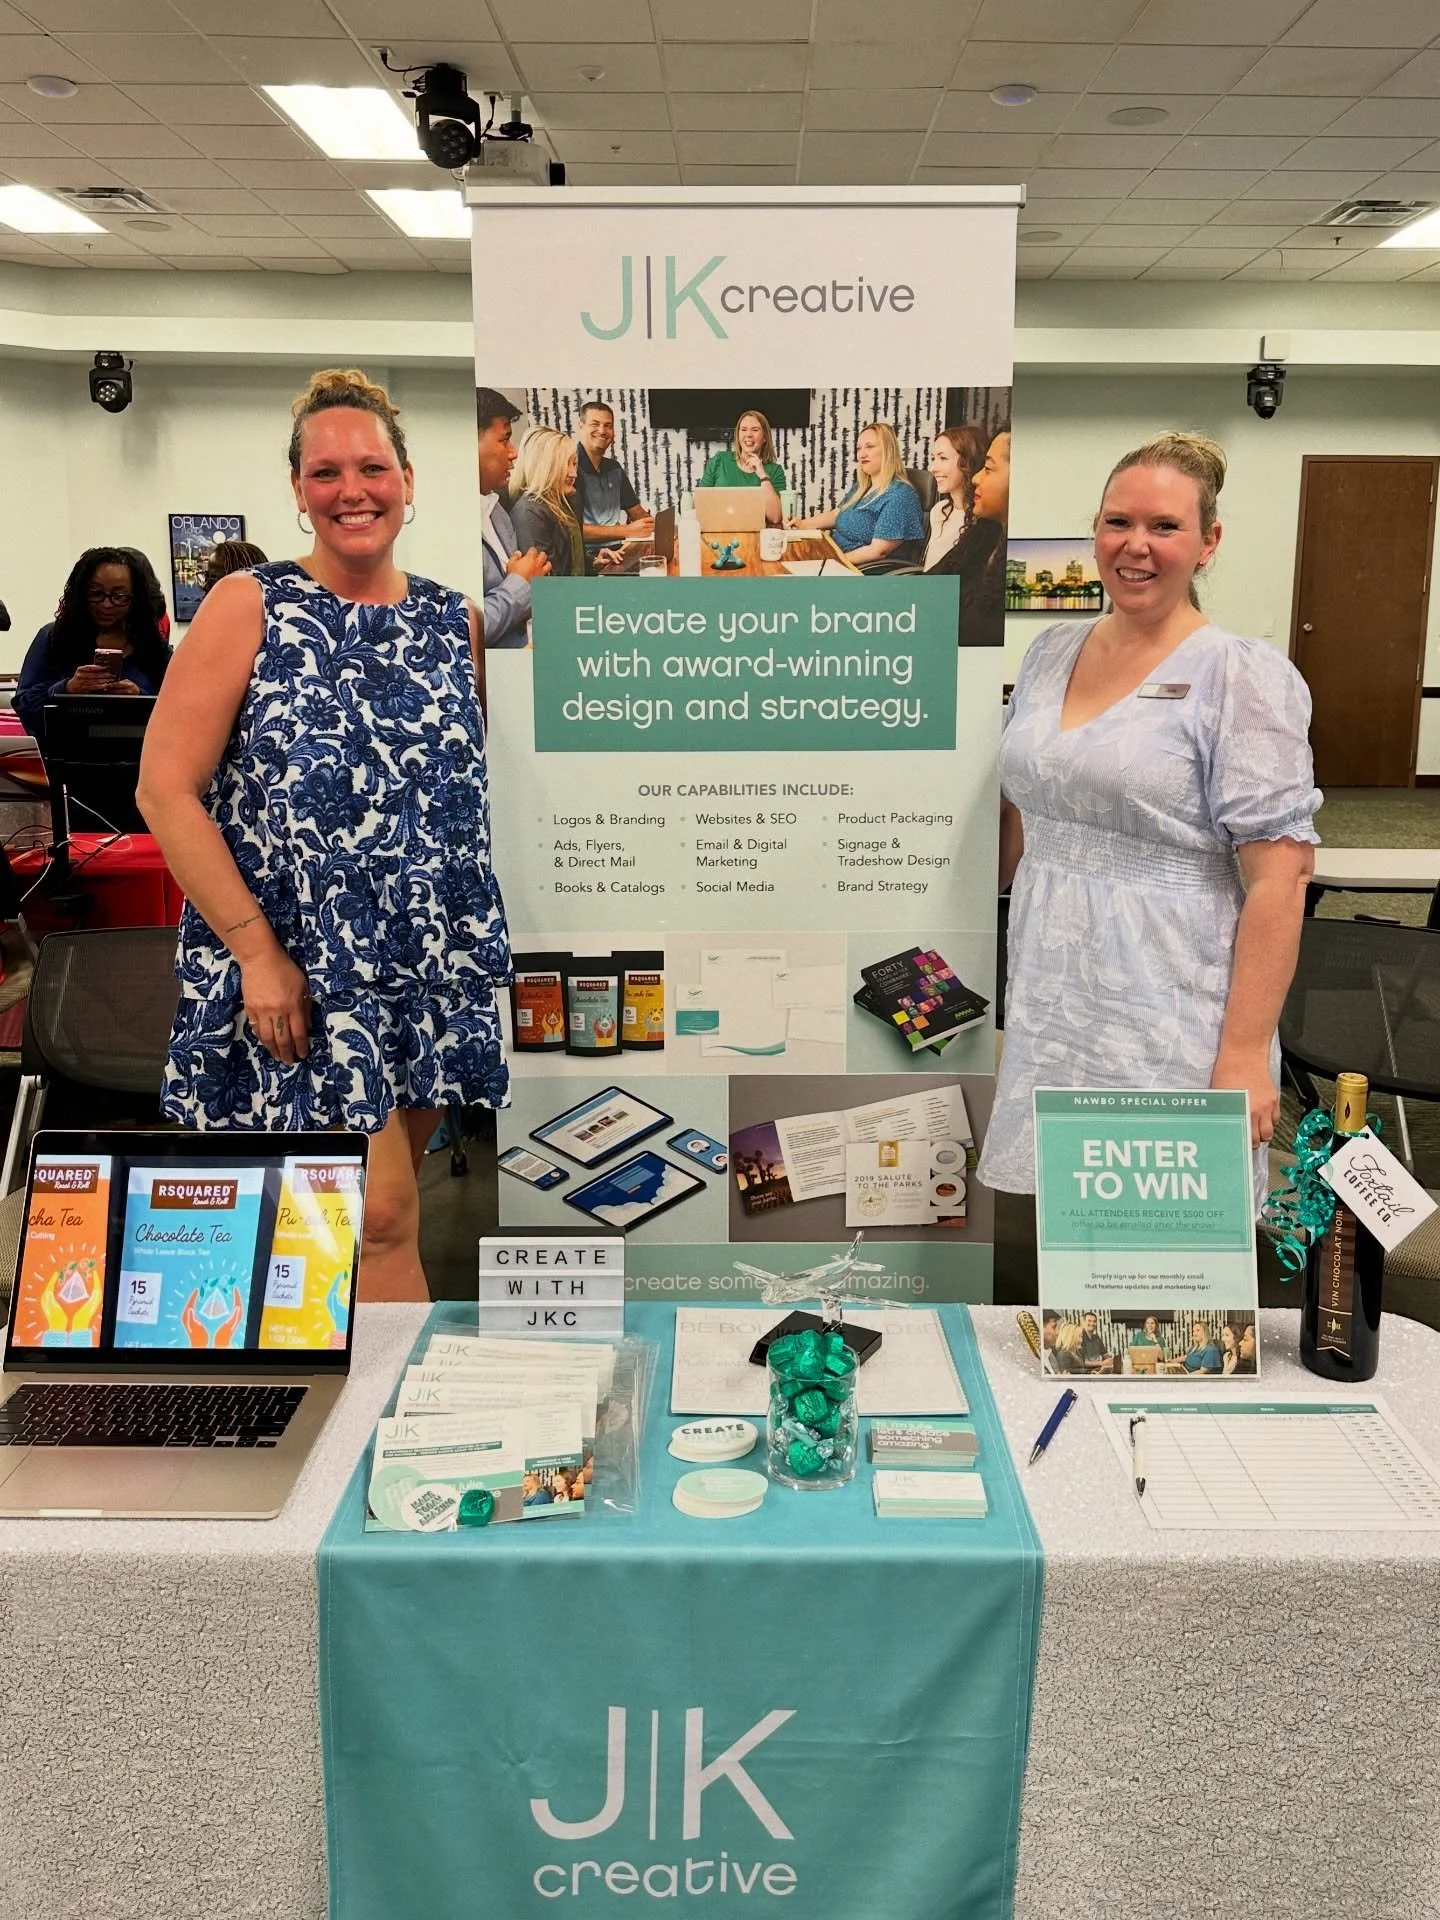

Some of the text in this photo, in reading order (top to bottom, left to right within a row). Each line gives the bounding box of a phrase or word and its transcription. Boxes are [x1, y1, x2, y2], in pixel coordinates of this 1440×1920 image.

[720, 276, 915, 313] creative
[172, 516, 240, 530] ORLANDO
[575, 604, 916, 643] Elevate your brand
[577, 648, 913, 685] with award-winning
[562, 691, 928, 730] design and strategy.
[638, 783, 854, 797] OUR CAPABILITIES INCLUDE:
[553, 813, 665, 828] Logos & Branding
[696, 813, 797, 825] Websites & SEO
[838, 812, 953, 827] Product Packaging
[553, 838, 625, 855] Ads, Flyers,
[696, 838, 787, 853] Email & Digital
[838, 838, 901, 852] Signage &
[553, 855, 636, 868] & Direct Mail
[696, 855, 758, 869] Marketing
[838, 854, 950, 868] Tradeshow Design
[555, 881, 665, 895] Books & Catalogs
[696, 881, 775, 893] Social Media
[838, 880, 929, 895] Brand Strategy
[872, 961, 904, 979] FORTY
[1074, 1096, 1208, 1107] NAWBO SPECIAL OFFER
[1083, 1140, 1198, 1168] ENTER
[878, 1174, 912, 1182] SALUTE
[1349, 1154, 1415, 1217] Foxtail
[159, 1185, 231, 1199] RSQUARED
[1073, 1172, 1208, 1200] TO WIN
[1343, 1169, 1392, 1227] COFFEE CO.
[60, 1208, 83, 1227] Tea
[1142, 1210, 1180, 1218] RECEIVE
[1183, 1210, 1204, 1218] $500
[135, 1223, 233, 1243] Chocolate Tea
[496, 1249, 606, 1265] CREATE
[1333, 1235, 1342, 1289] CHOCOLAT
[274, 1264, 290, 1278] 15
[1091, 1273, 1112, 1281] Simply
[1160, 1273, 1185, 1281] monthly
[131, 1280, 147, 1295] 15
[508, 1279, 585, 1295] WITH
[624, 1274, 701, 1290] create
[1124, 1283, 1150, 1291] updates
[1331, 1289, 1339, 1307] VIN
[527, 1311, 578, 1326] JKC
[681, 1423, 744, 1435] CREATE
[533, 1851, 798, 1898] creative
